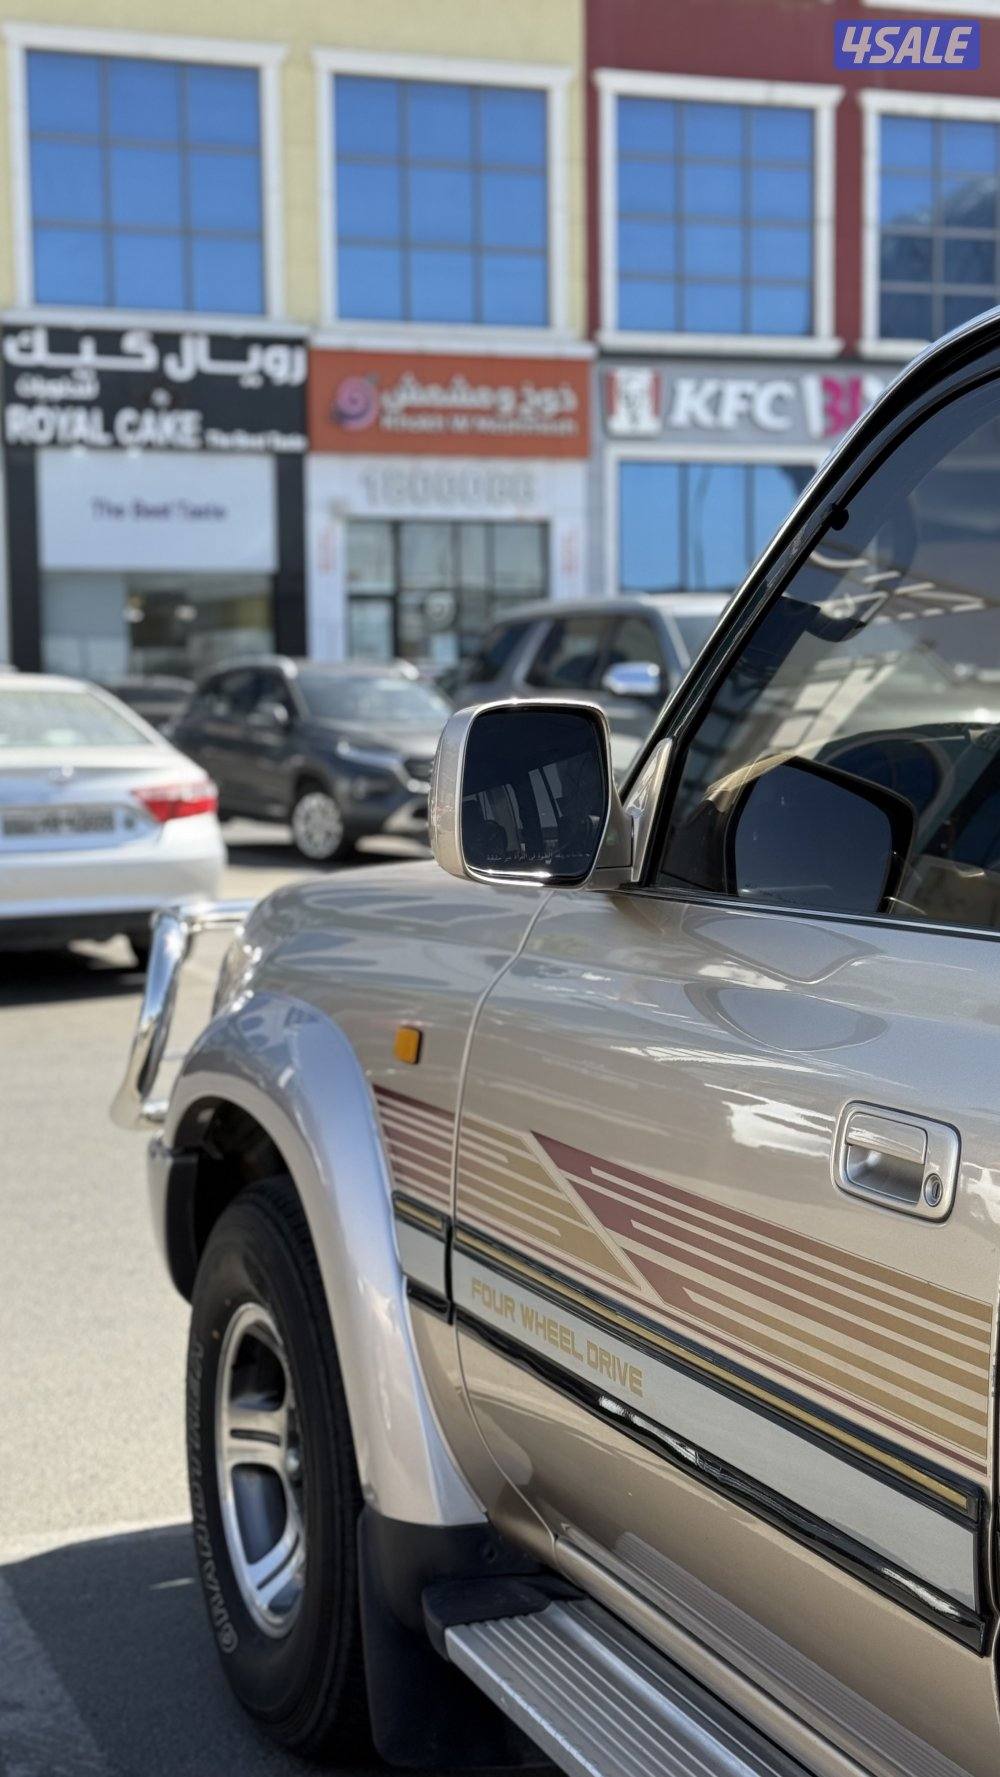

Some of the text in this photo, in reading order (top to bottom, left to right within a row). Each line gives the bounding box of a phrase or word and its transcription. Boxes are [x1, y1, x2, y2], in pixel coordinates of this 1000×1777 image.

[6, 404, 112, 446] ROYAL
[115, 407, 203, 448] CAKE
[670, 376, 796, 431] KFC
[471, 1276, 644, 1398] FOUR WHEEL DRIVE
